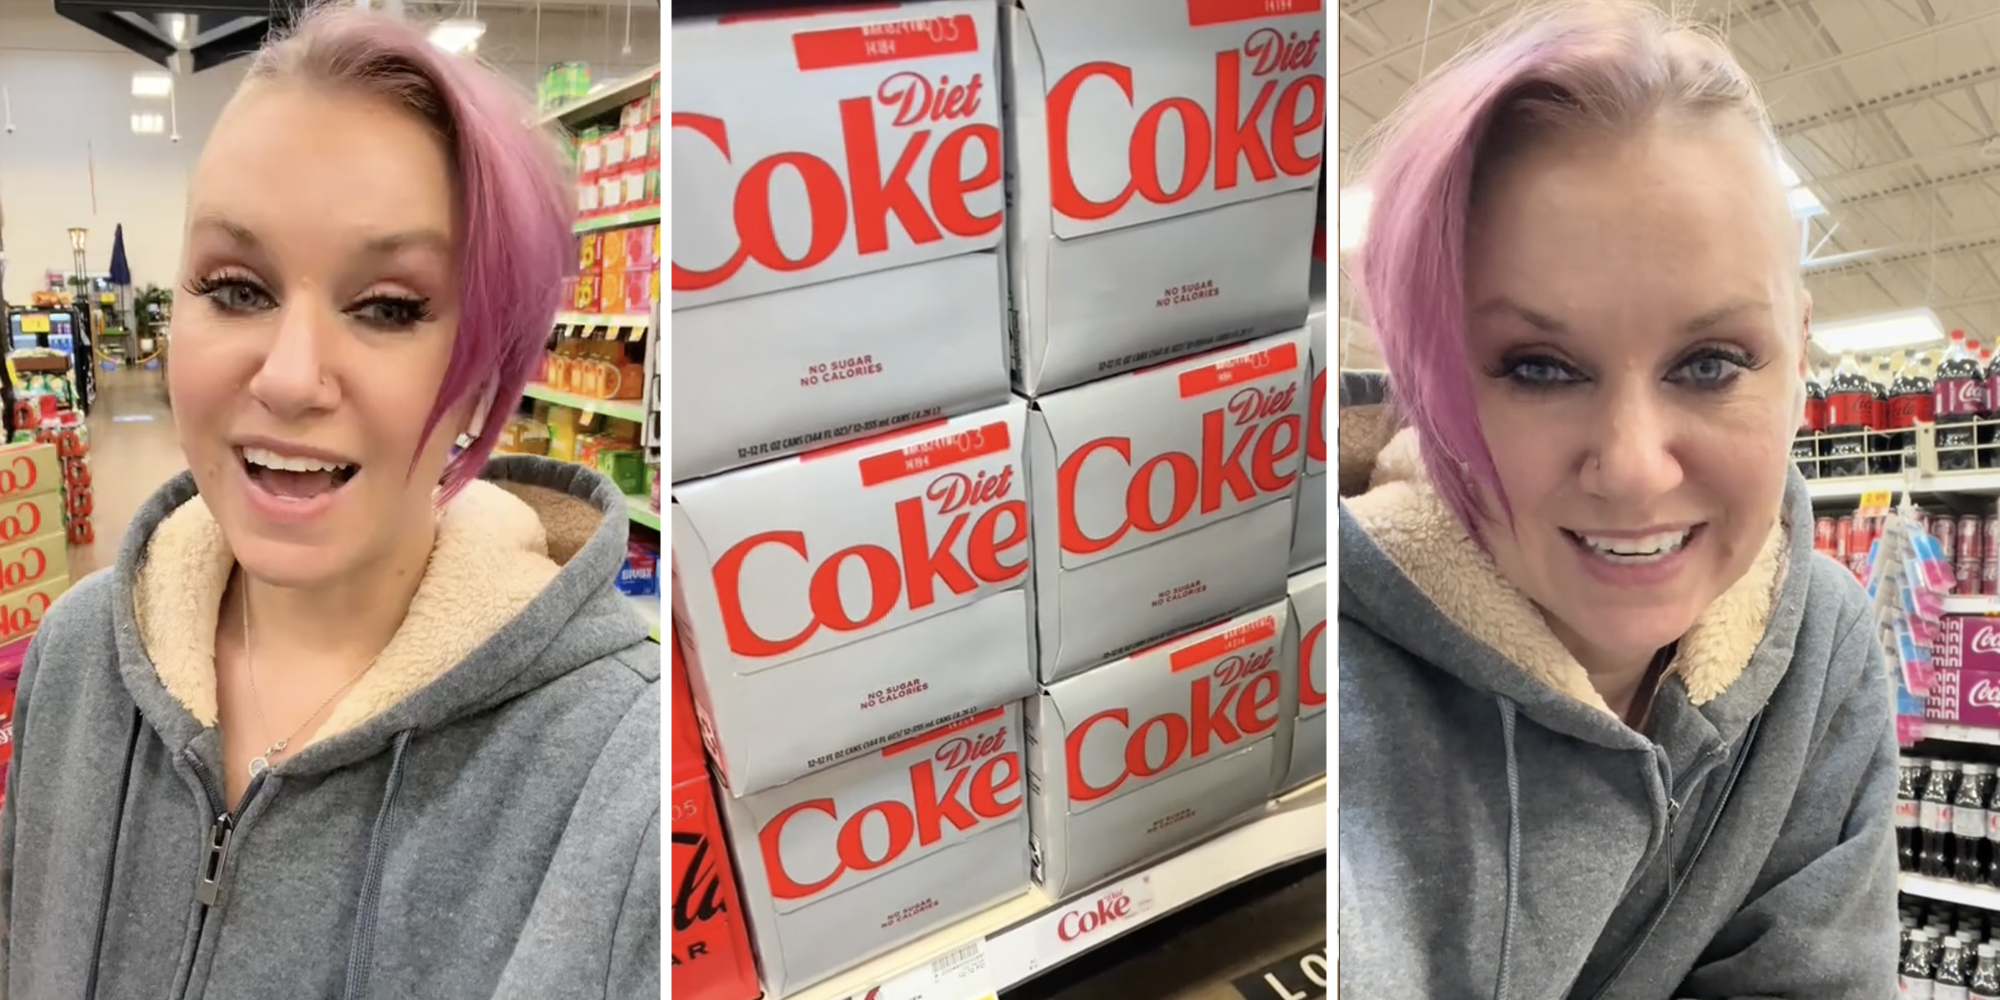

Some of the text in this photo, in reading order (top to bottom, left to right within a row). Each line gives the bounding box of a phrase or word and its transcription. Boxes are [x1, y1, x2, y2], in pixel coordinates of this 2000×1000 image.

[1244, 27, 1321, 76] Diet
[877, 71, 982, 126] Diet
[1046, 48, 1326, 221] Coke
[1156, 287, 1220, 308] NO CALORIES
[1164, 279, 1213, 297] NO SUGAR
[800, 363, 883, 387] NO CALORIES
[809, 354, 873, 375] NO SUGAR
[1228, 382, 1296, 425] Diet
[782, 436, 804, 449] CANS
[927, 464, 1014, 515] Diet
[1057, 407, 1301, 554] Coke
[712, 496, 1028, 659] Coke
[1158, 579, 1201, 599] NO SUGAR
[1151, 584, 1207, 608] NO CALORIES
[1214, 648, 1274, 687] Diet
[1931, 654, 1962, 667] mini
[860, 682, 929, 709] NO CALORIES
[868, 678, 921, 700] NO SUGAR
[1927, 706, 1959, 720] mini
[845, 744, 862, 755] CANS
[935, 726, 1008, 772] Diet
[1065, 669, 1279, 802] Coke
[758, 751, 1023, 899] Coke
[881, 900, 939, 929] NO CALORIES
[887, 897, 932, 920] NO SUGAR
[1057, 895, 1131, 941] Coke
[1264, 948, 1326, 1000] LO
